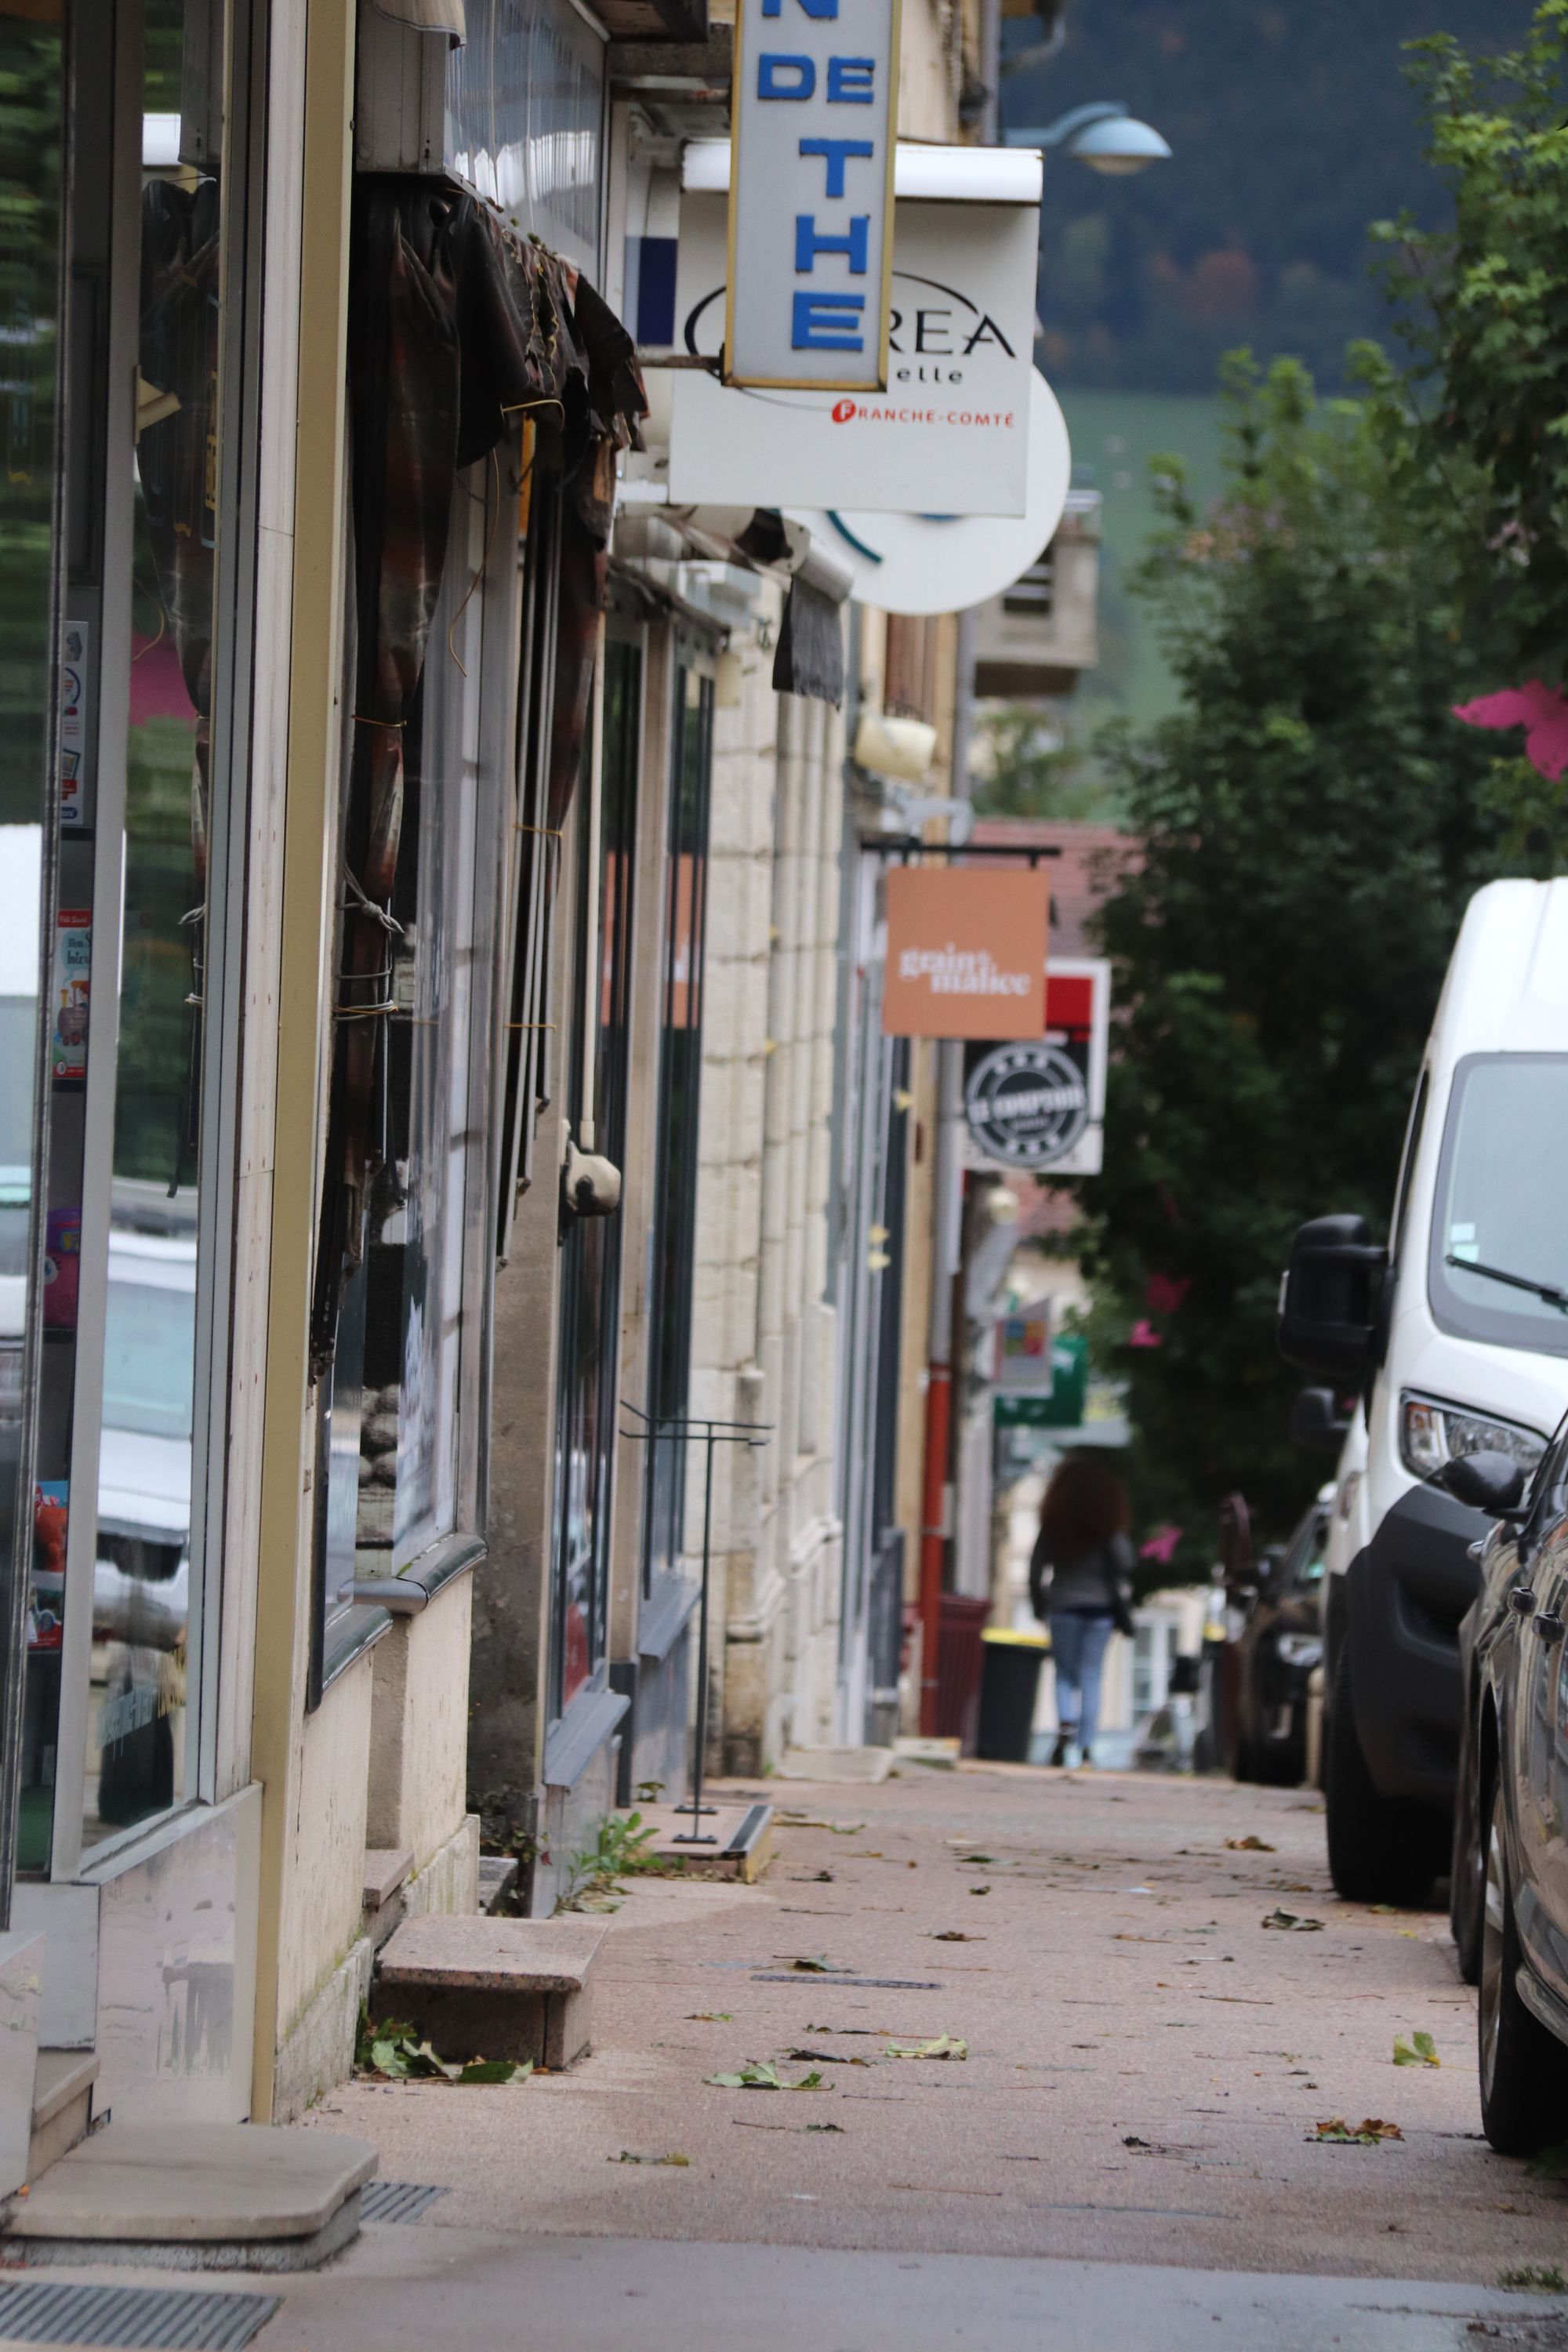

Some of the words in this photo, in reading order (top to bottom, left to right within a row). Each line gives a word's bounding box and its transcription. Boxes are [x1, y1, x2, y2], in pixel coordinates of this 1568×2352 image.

[757, 53, 876, 103] DE
[791, 138, 874, 352] THE
[836, 399, 1014, 427] FRANCHE-COMTÉ
[898, 942, 975, 982] grain
[931, 964, 1030, 996] malice
